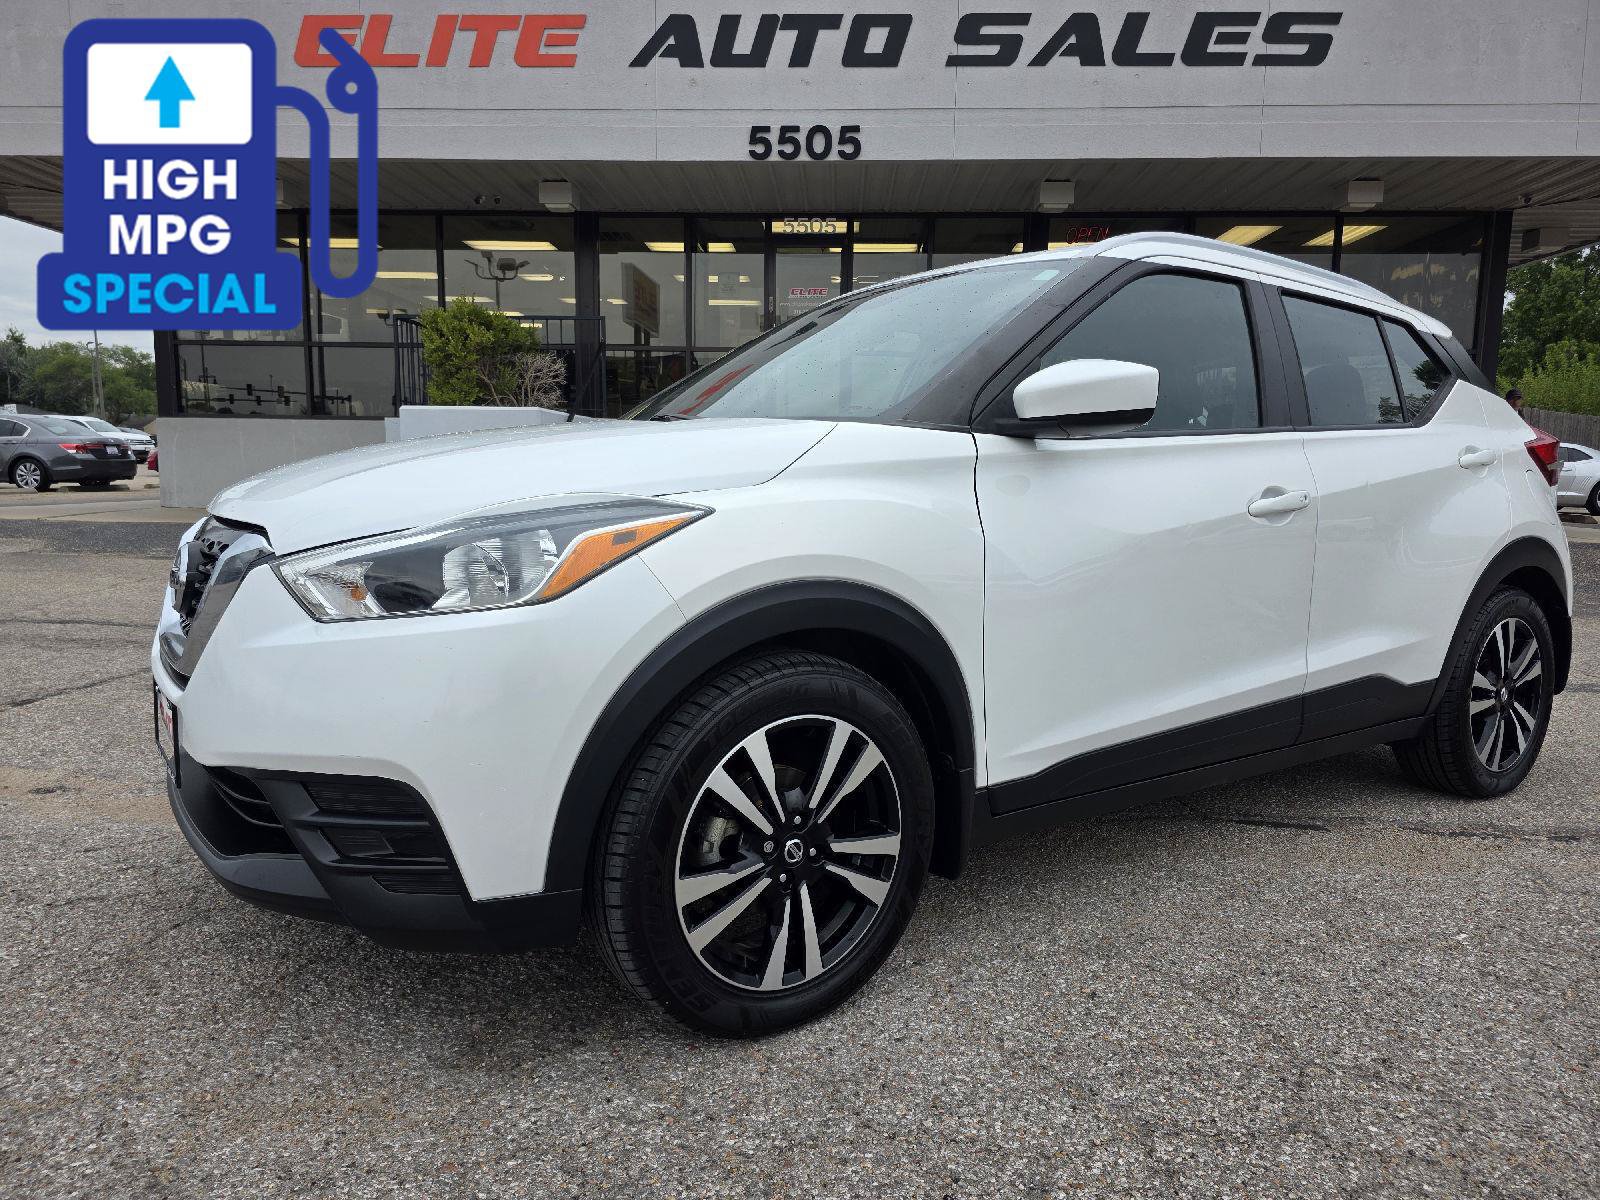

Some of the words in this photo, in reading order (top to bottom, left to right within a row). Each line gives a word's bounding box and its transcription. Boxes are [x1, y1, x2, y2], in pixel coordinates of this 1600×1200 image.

[294, 14, 586, 68] ELITE
[629, 13, 913, 68] AUTO
[945, 12, 1343, 68] SALES
[748, 125, 862, 160] 5505
[783, 217, 837, 234] 5505
